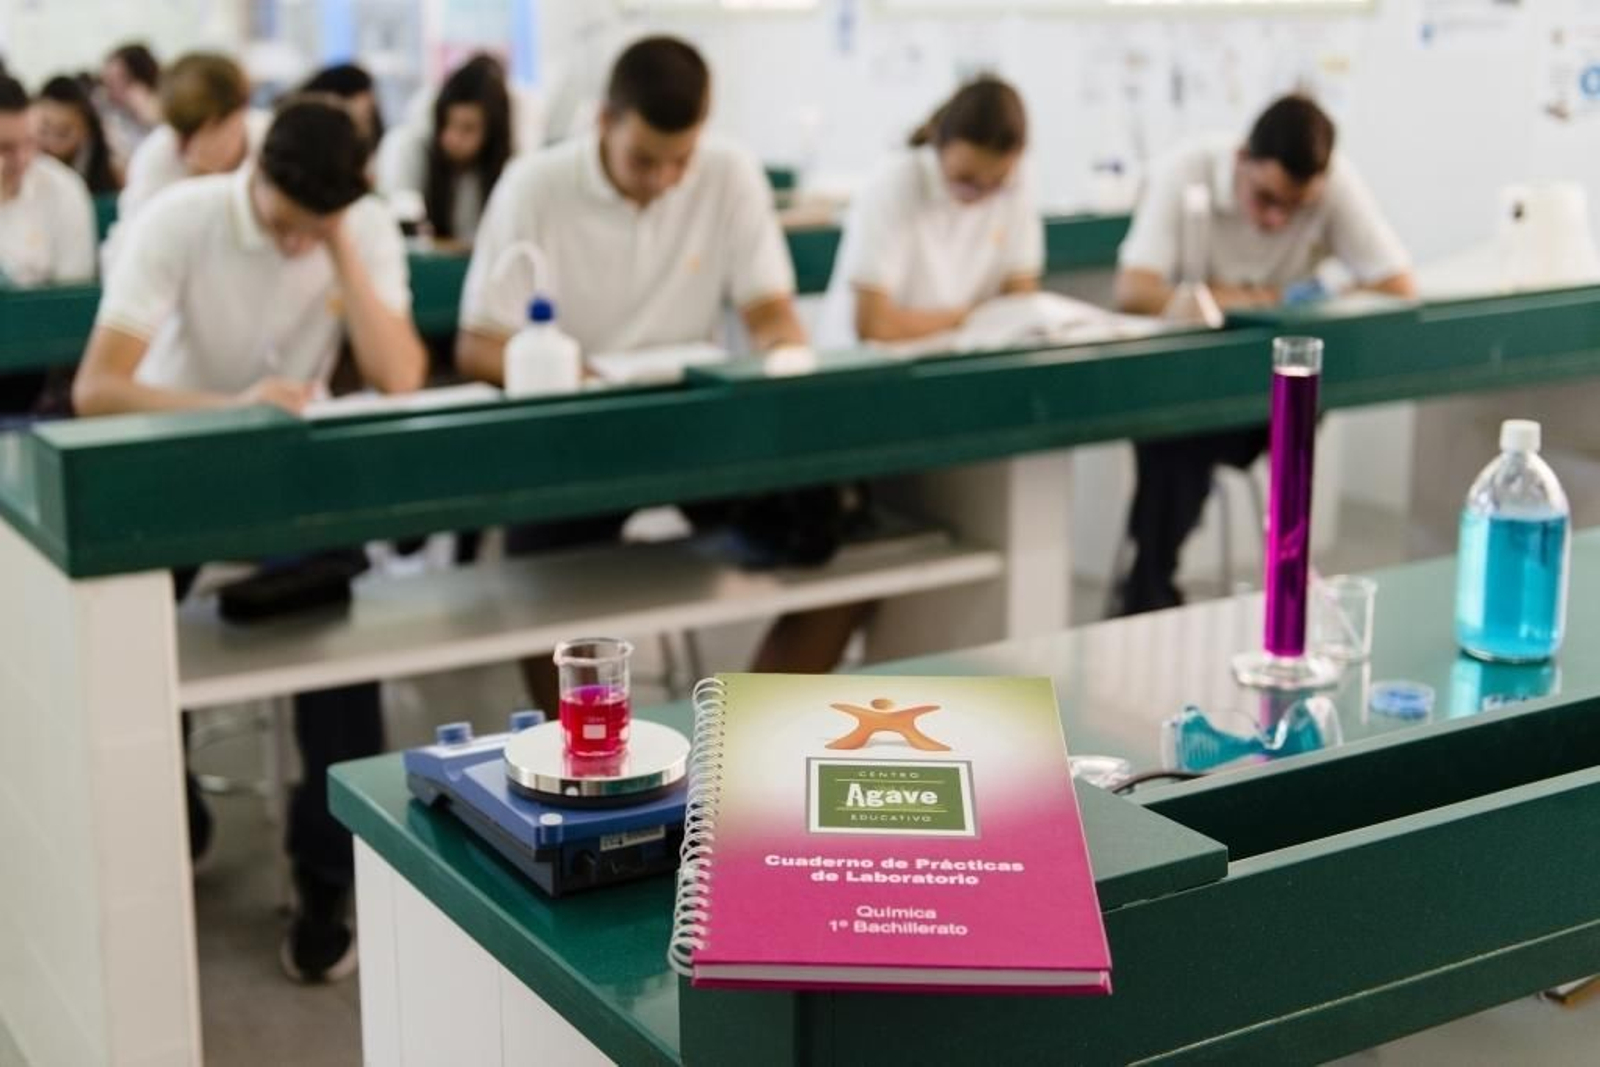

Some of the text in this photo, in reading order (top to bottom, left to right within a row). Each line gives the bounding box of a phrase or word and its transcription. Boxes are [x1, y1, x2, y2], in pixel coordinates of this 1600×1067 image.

[859, 771, 920, 779] CENTRO
[846, 783, 938, 807] Agave
[851, 814, 932, 822] EDUCATIVO
[765, 855, 1024, 872] Cuaderno de Prácticas
[811, 871, 979, 885] de Laboratorio
[854, 920, 968, 936] Bachillerato
